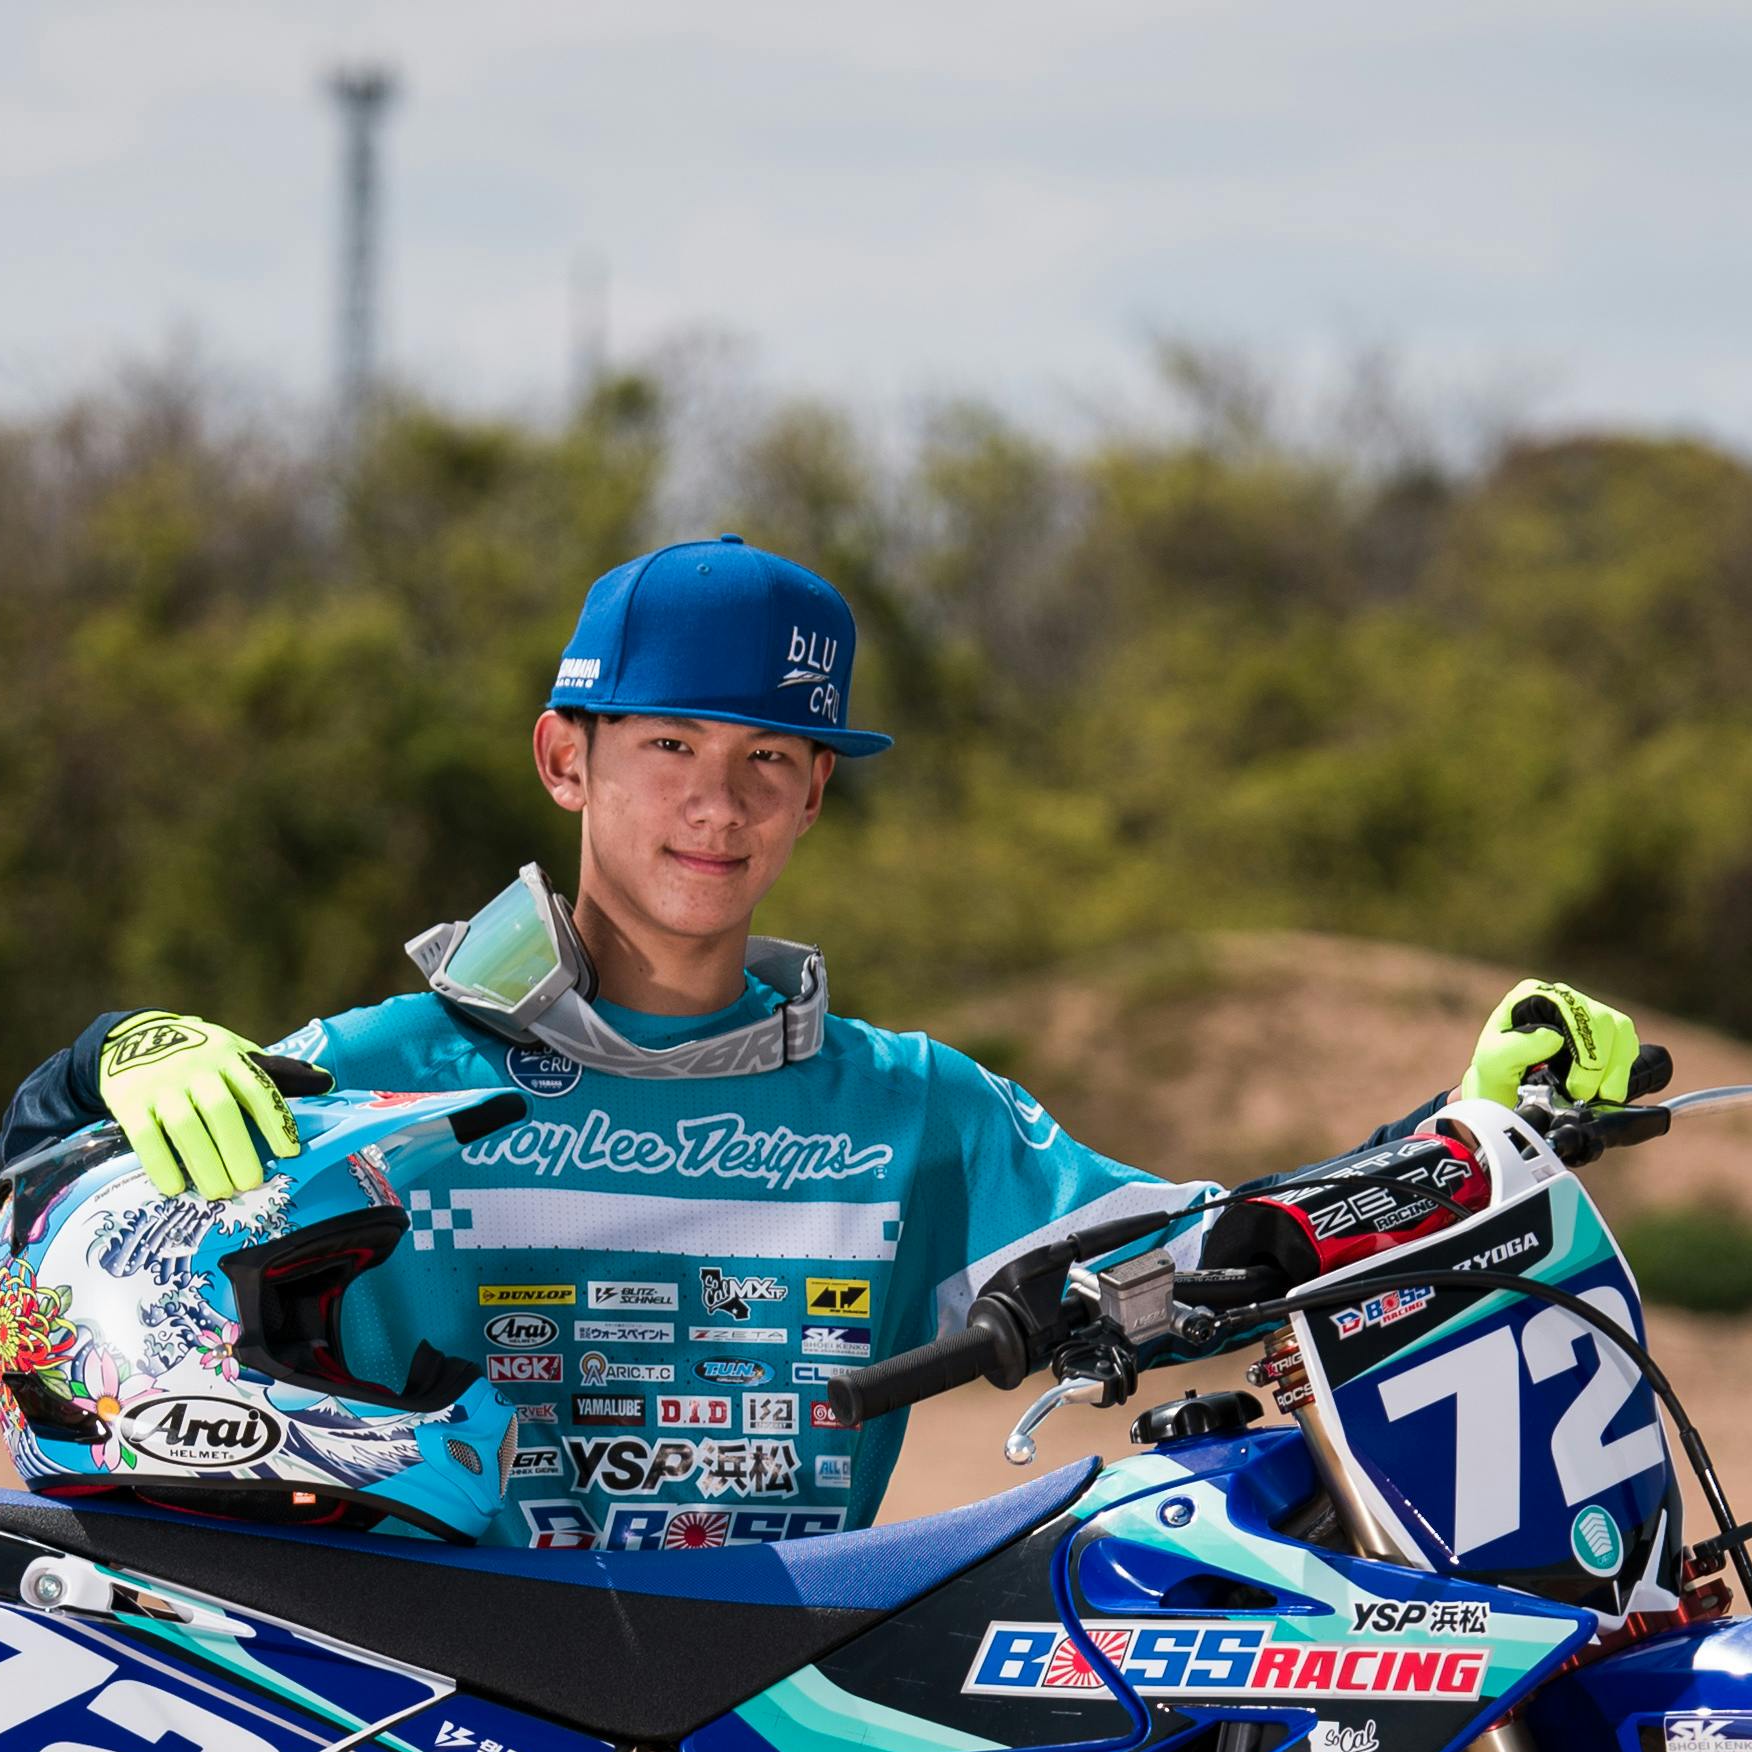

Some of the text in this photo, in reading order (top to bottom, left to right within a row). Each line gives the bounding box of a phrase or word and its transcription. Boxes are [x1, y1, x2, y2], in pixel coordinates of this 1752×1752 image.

[568, 1110, 676, 1172] Lee
[677, 1113, 893, 1189] Designs
[498, 1289, 573, 1300] DUNLOP
[729, 1278, 770, 1299] MX
[493, 1318, 549, 1340] Arai
[712, 1330, 784, 1339] ZETA
[490, 1357, 552, 1380] NGK
[517, 1405, 554, 1418] RVEK
[577, 1398, 642, 1416] YAMALUBE
[661, 1399, 727, 1424] D.I.D
[130, 1403, 263, 1449] Arai
[1378, 1286, 1665, 1556] 72
[169, 1448, 230, 1460] HELMET
[568, 1441, 796, 1493] YSP 浜松
[1351, 1602, 1489, 1635] YSP 浜松
[1252, 1645, 1485, 1694] RACING
[1668, 1741, 1711, 1752] SHOEI
